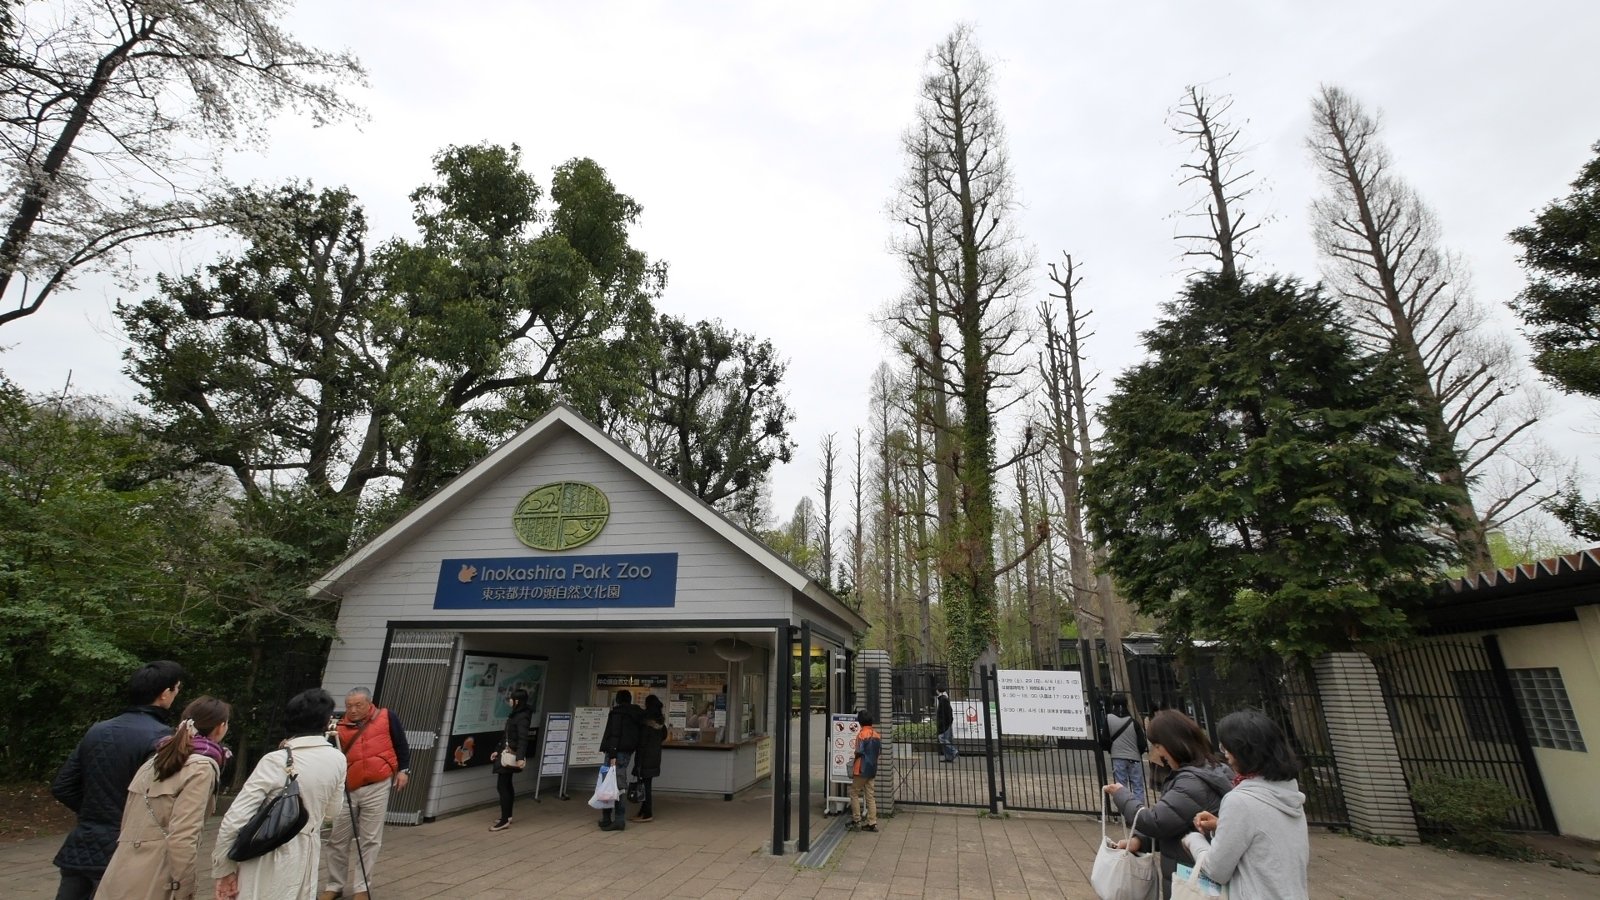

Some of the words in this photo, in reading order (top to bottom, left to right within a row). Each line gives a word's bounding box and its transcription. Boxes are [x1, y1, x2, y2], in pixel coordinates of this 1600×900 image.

[481, 564, 566, 582] Inokashira
[572, 563, 610, 580] Park
[617, 562, 652, 579] Zoo
[482, 584, 621, 601] 東京都井の頭自然文化園
